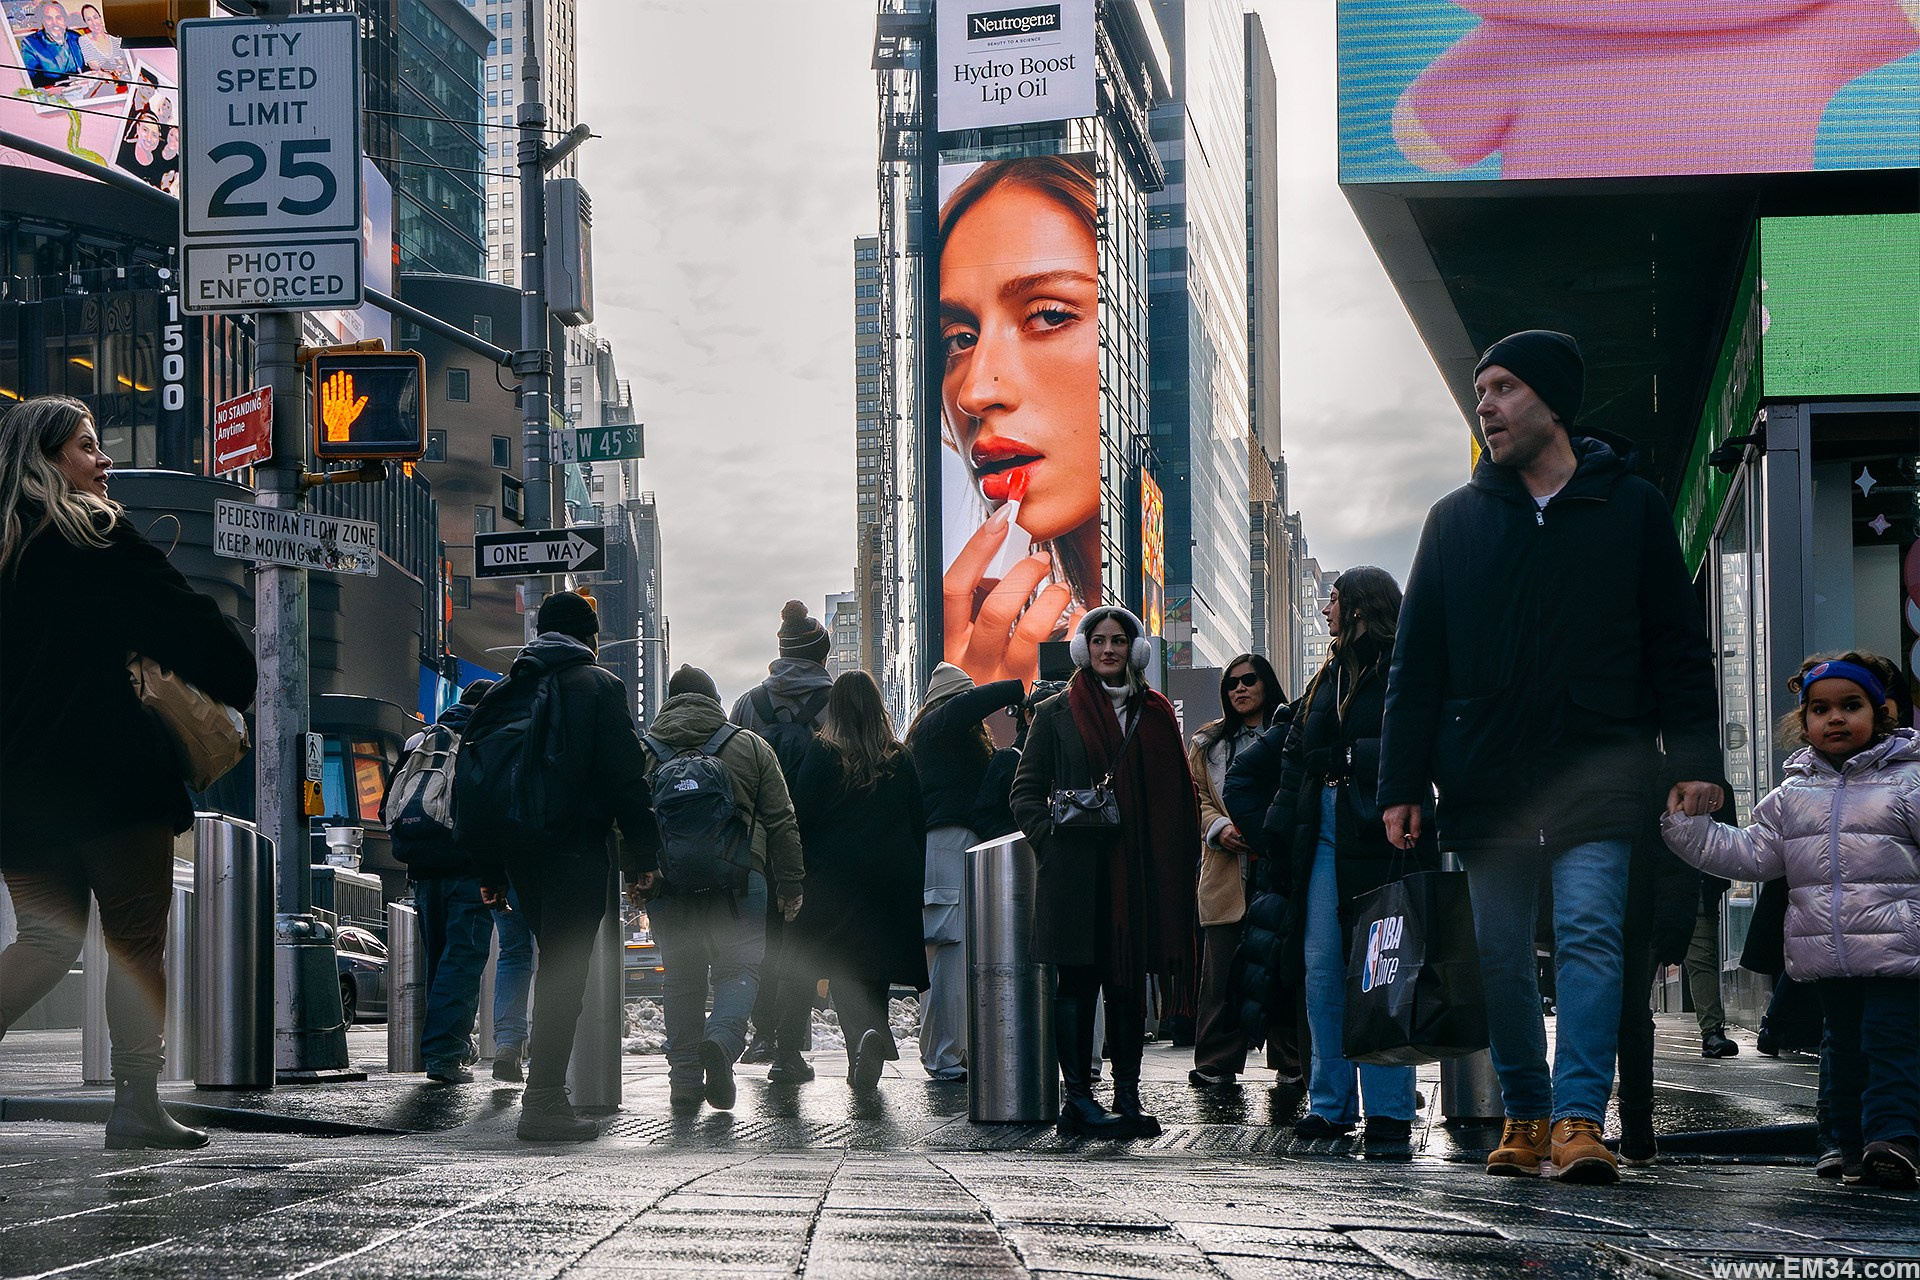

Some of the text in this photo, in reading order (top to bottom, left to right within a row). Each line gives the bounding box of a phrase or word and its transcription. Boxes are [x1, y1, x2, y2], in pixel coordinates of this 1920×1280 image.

[973, 13, 1055, 33] Neutrogena
[231, 32, 302, 57] CITY
[216, 66, 318, 93] SPEED
[953, 53, 1076, 85] Hydro Boost
[981, 77, 1048, 105] Lip Oil
[228, 101, 308, 126] LIMIT
[207, 138, 337, 218] 25
[227, 251, 316, 274] PHOTO
[200, 274, 344, 300] ENFORCED
[162, 295, 185, 411] 1500
[217, 397, 262, 424] NO STANDING
[217, 421, 245, 441] Anytime
[579, 427, 638, 458] W 45 St
[218, 505, 376, 546] PEDESTRIAN FLOW ZONE
[218, 531, 305, 562] KEEP MOVING
[493, 541, 585, 564] ONE WAY
